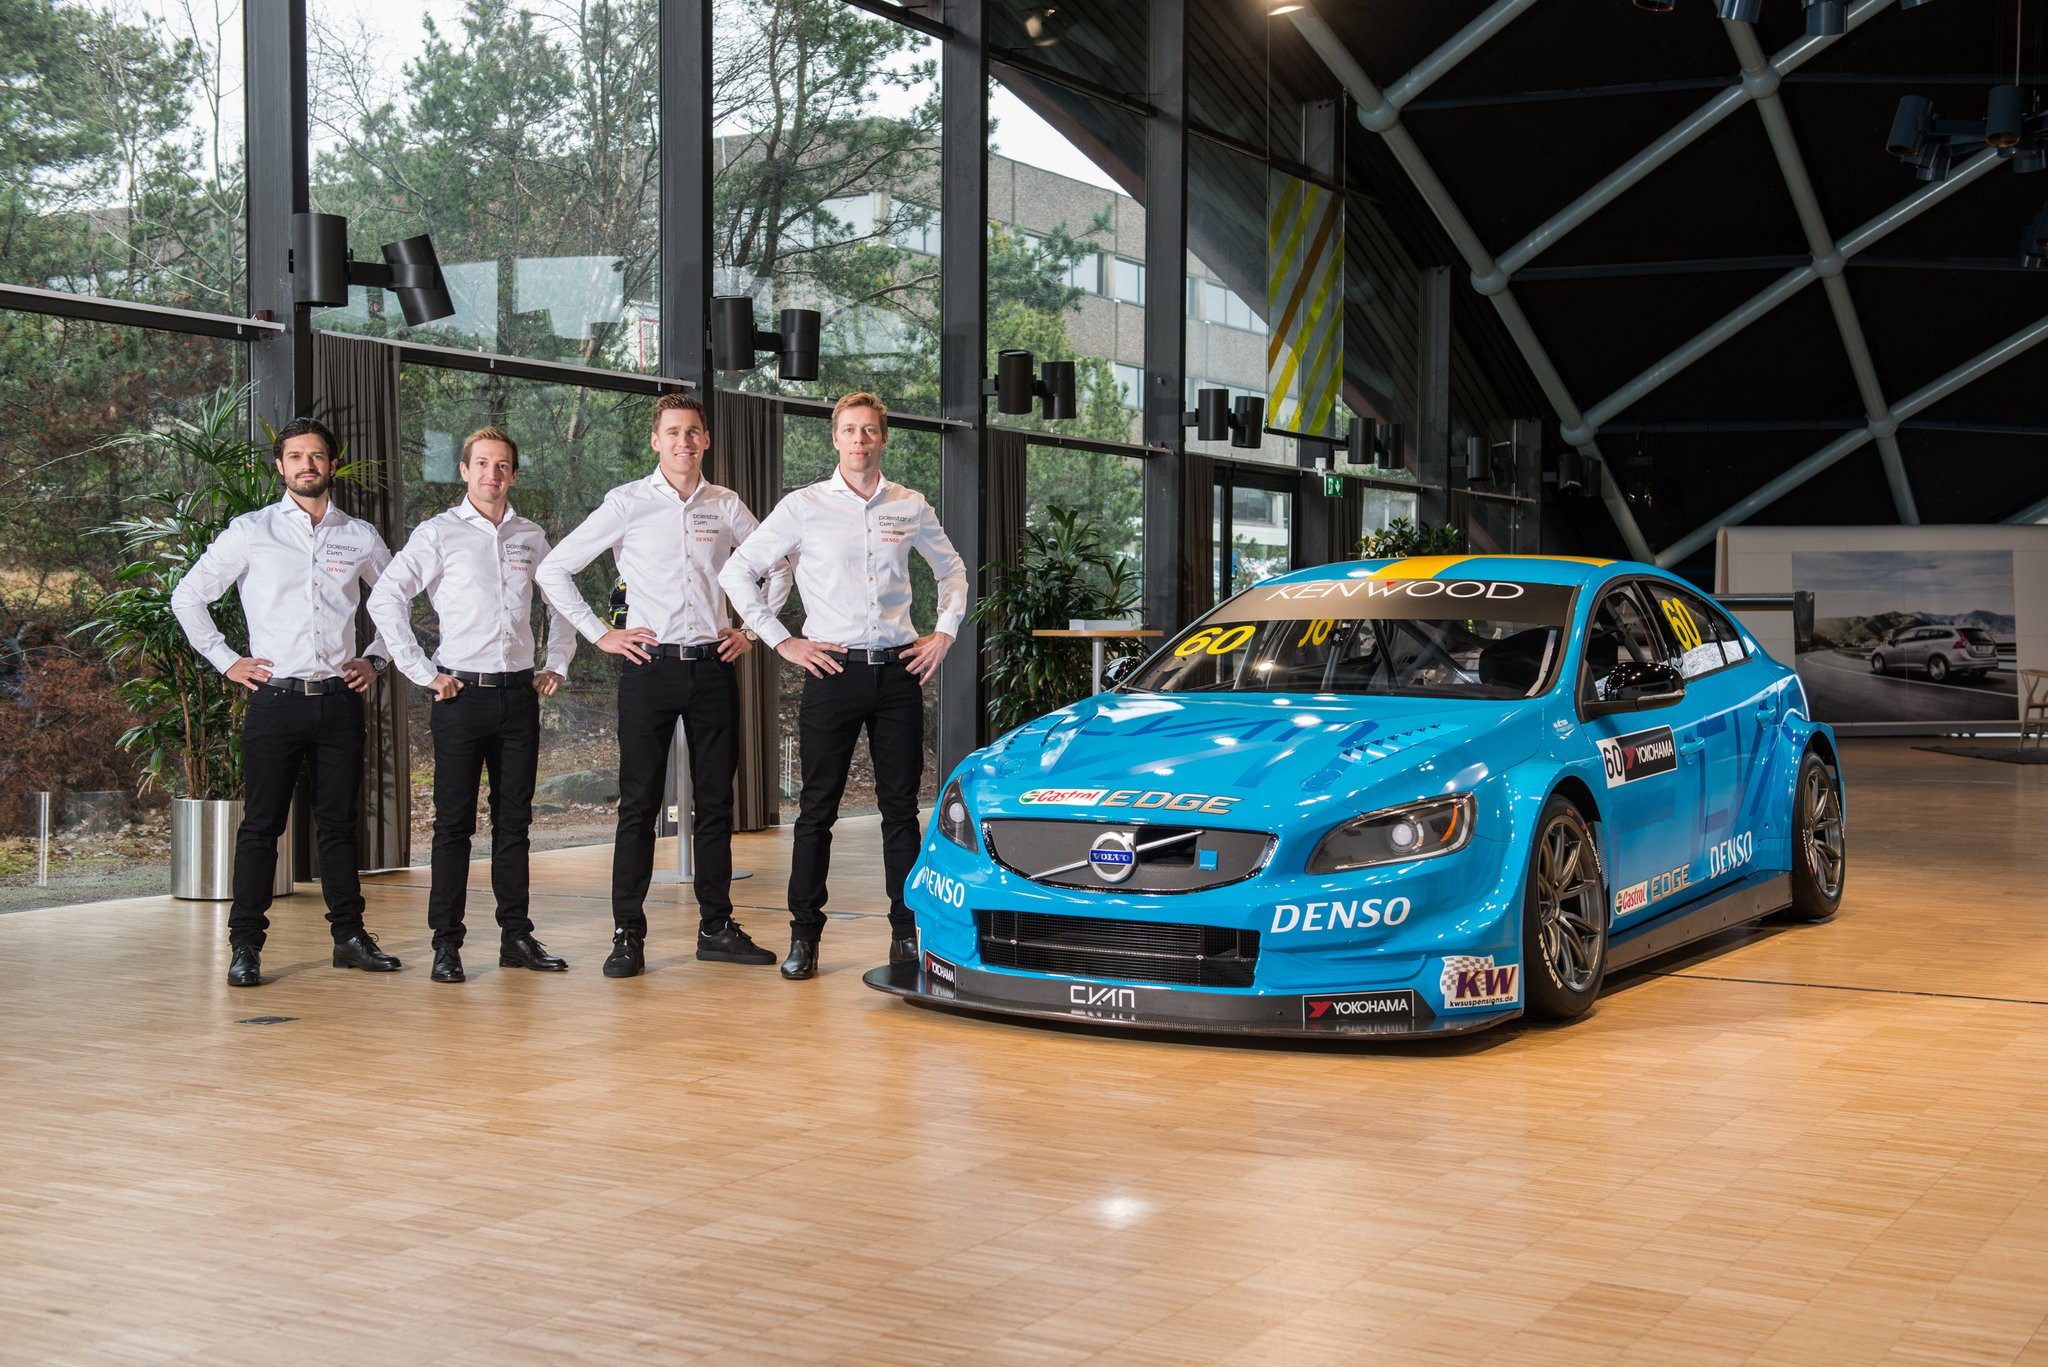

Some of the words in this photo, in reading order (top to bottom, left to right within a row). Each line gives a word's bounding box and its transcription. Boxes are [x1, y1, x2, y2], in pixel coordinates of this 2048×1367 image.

[1266, 580, 1524, 600] KENWOOD
[1661, 597, 1702, 651] 60
[1174, 625, 1256, 657] 60
[1602, 744, 1623, 779] 60
[1635, 740, 1675, 764] YOKOHAMA
[1037, 789, 1101, 802] Castrol
[1099, 789, 1245, 815] EDGE
[1091, 852, 1131, 862] VOLVO
[1710, 830, 1753, 880] DENSO
[1622, 883, 1647, 910] Castrol
[1650, 863, 1693, 902] EDGE
[1270, 896, 1411, 934] DENSO
[1455, 965, 1517, 999] KW
[1333, 998, 1409, 1015] YOKOHAMA
[1449, 995, 1514, 1008] kwsuspensions.de
